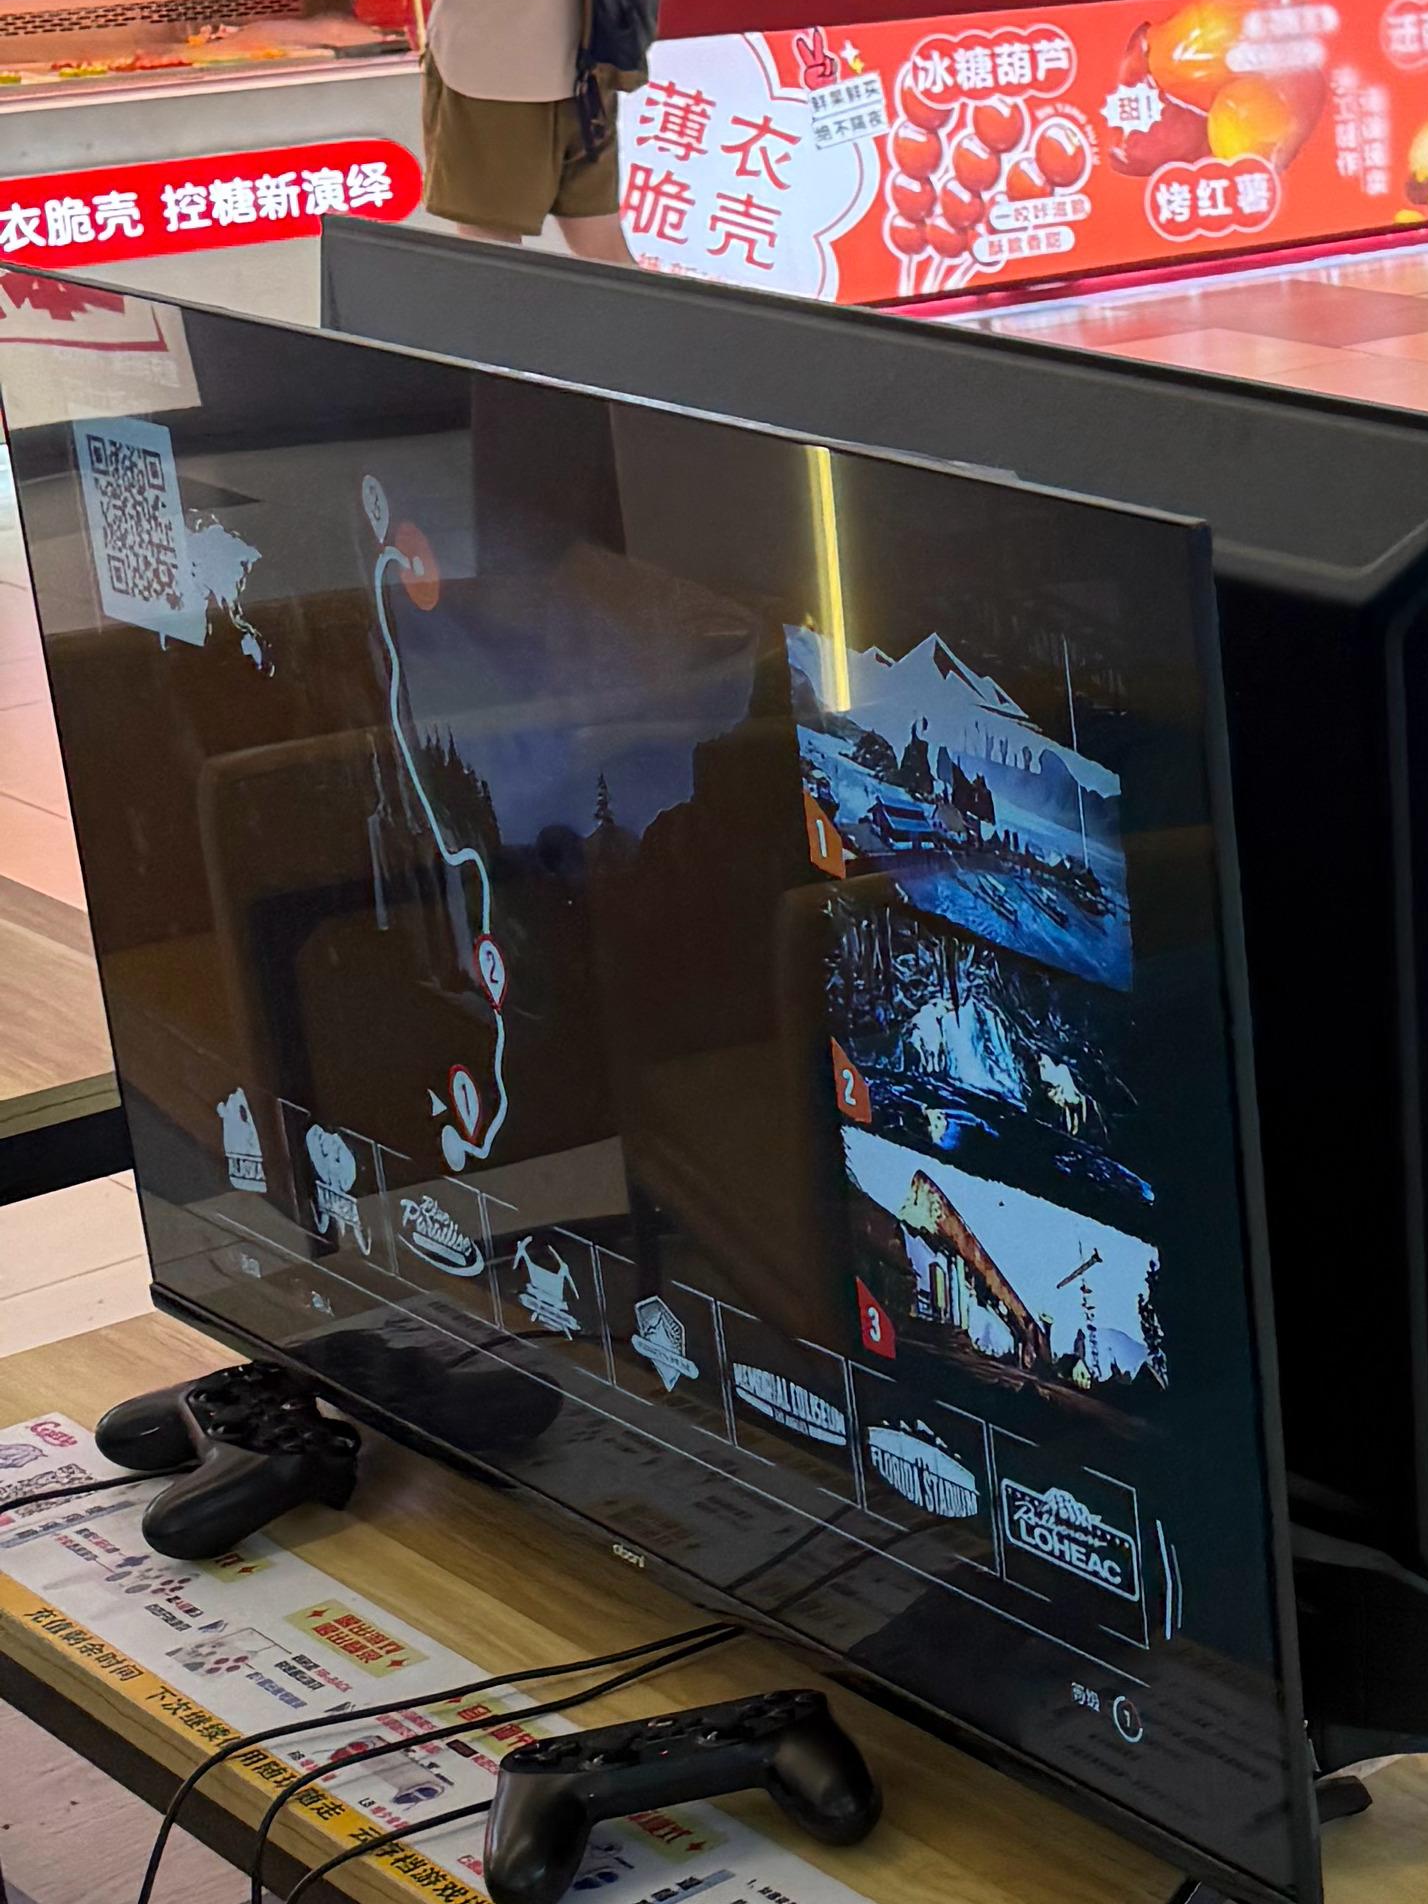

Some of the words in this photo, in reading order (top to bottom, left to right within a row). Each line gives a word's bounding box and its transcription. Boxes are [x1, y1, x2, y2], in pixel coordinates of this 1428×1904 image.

[914, 36, 1074, 92] 冰糖葫芦
[636, 80, 801, 191] 薄衣
[161, 161, 393, 230] 控糖新演绎
[620, 162, 782, 271] 脆壳
[1155, 170, 1271, 224] 烤红薯
[815, 818, 828, 860] 1
[484, 948, 499, 986] 2
[842, 1067, 856, 1108] 2
[868, 1303, 882, 1342] 3
[870, 1445, 925, 1508] FLORIDA
[923, 1467, 979, 1518] STADIUM
[1019, 1519, 1122, 1586] LOHEAC
[24, 1606, 144, 1682] 充值剩余时间
